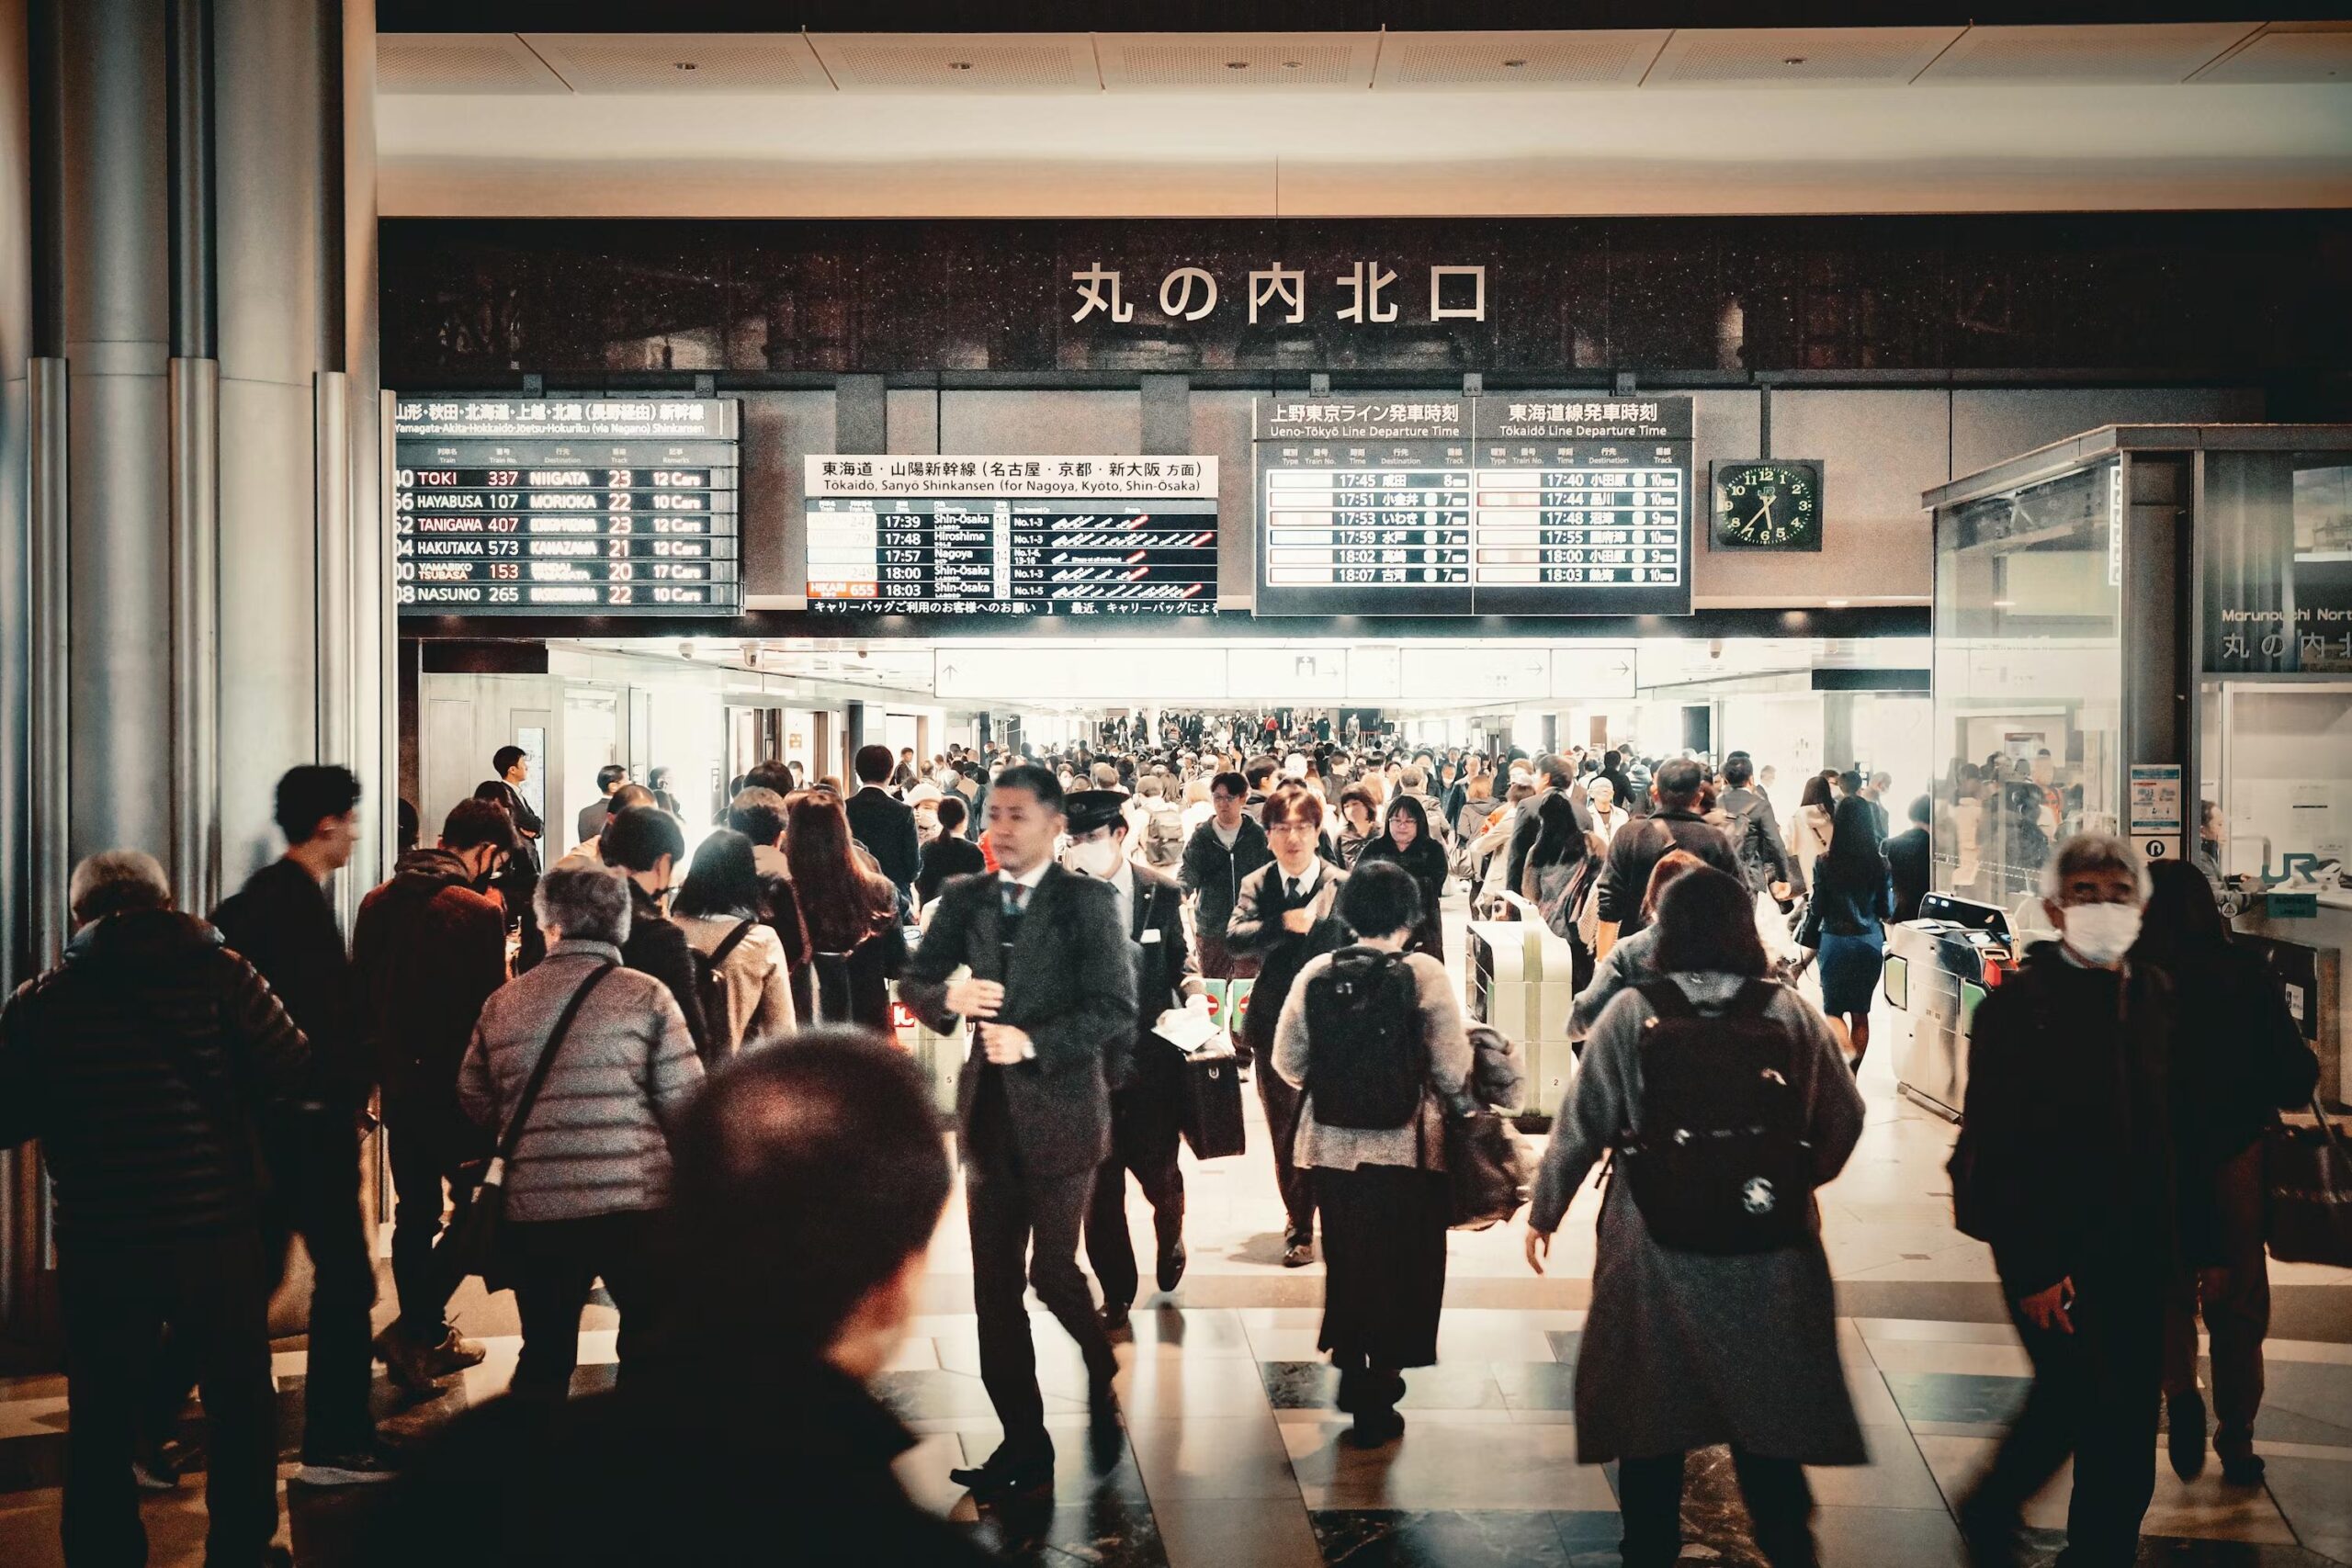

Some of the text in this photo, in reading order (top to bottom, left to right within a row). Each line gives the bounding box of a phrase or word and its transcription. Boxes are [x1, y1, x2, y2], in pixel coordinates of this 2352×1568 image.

[1070, 262, 1487, 323] 丸の内北口
[1271, 404, 1459, 423] 上野東京ライン発車時刻
[1509, 403, 1657, 422] 東海道線発車時刻
[652, 423, 705, 434] Shinkansen
[1343, 425, 1365, 436] Line
[1370, 425, 1428, 438] Departure
[1432, 425, 1459, 436] Time
[1548, 424, 1572, 436] Line
[1576, 424, 1635, 438] Departure
[1639, 424, 1667, 436] Time
[1283, 457, 1298, 466] Type
[1489, 457, 1506, 466] Type
[417, 471, 458, 485] TOKI
[488, 471, 518, 485] 337
[609, 470, 632, 488] 23
[653, 471, 669, 486] 12
[672, 471, 701, 486] Cars
[1340, 474, 1375, 487] 17:45
[1547, 474, 1584, 487] 17:40
[1745, 475, 1758, 485] 11
[1759, 471, 1773, 481] 12
[1780, 474, 1786, 484] 1
[881, 479, 919, 493] Sanyō
[922, 479, 993, 491] Shinkansen
[999, 479, 1023, 492] (for
[1026, 479, 1077, 493] Nagoya,
[1081, 479, 1122, 493] Kyōto,
[1732, 486, 1746, 496] 10
[1792, 484, 1802, 494] 2
[417, 495, 484, 508] HAYABUSA
[489, 495, 518, 508] 107
[609, 493, 632, 511] 22
[653, 495, 670, 509] 10
[672, 495, 701, 509] Cars
[1340, 493, 1375, 505] 17:51
[1547, 492, 1584, 505] 17:44
[1724, 501, 1734, 511] 9
[1798, 501, 1808, 511] 3
[885, 515, 921, 528] 17:39
[1340, 513, 1375, 525] 17:53
[1547, 512, 1583, 524] 17:48
[1731, 517, 1741, 527] 8
[1791, 517, 1801, 527] 4
[417, 518, 484, 532] TANIGAWA
[488, 518, 518, 532] 407
[609, 516, 632, 534] 23
[653, 518, 669, 533] 12
[672, 518, 701, 533] Cars
[885, 533, 921, 545] 17:48
[933, 532, 986, 542] Hiroshima
[1340, 531, 1375, 544] 17:59
[1547, 531, 1583, 544] 17:55
[1745, 527, 1755, 537] 7
[1760, 530, 1770, 540] 6
[1776, 527, 1785, 537] 5
[417, 541, 485, 555] HAKUTAKA
[489, 541, 518, 555] 573
[609, 540, 628, 557] 21
[653, 541, 669, 556] 12
[672, 541, 701, 556] Cars
[885, 550, 921, 562] 17:57
[933, 548, 973, 559] Nagoya
[1340, 550, 1375, 562] 18:02
[1547, 549, 1583, 562] 18:00
[490, 564, 518, 578] 153
[609, 562, 632, 580] 20
[653, 564, 669, 579] 17
[672, 564, 701, 579] Cars
[885, 567, 921, 580] 18:00
[1340, 569, 1375, 581] 18:07
[1547, 568, 1583, 581] 18:03
[417, 588, 481, 601] NASUNO
[489, 588, 518, 601] 265
[609, 586, 632, 604] 22
[653, 588, 670, 602] 10
[672, 588, 701, 602] Cars
[850, 584, 876, 595] 655
[885, 584, 921, 597] 18:03
[2222, 608, 2310, 622] Marunohi
[2261, 853, 2318, 884] JR
